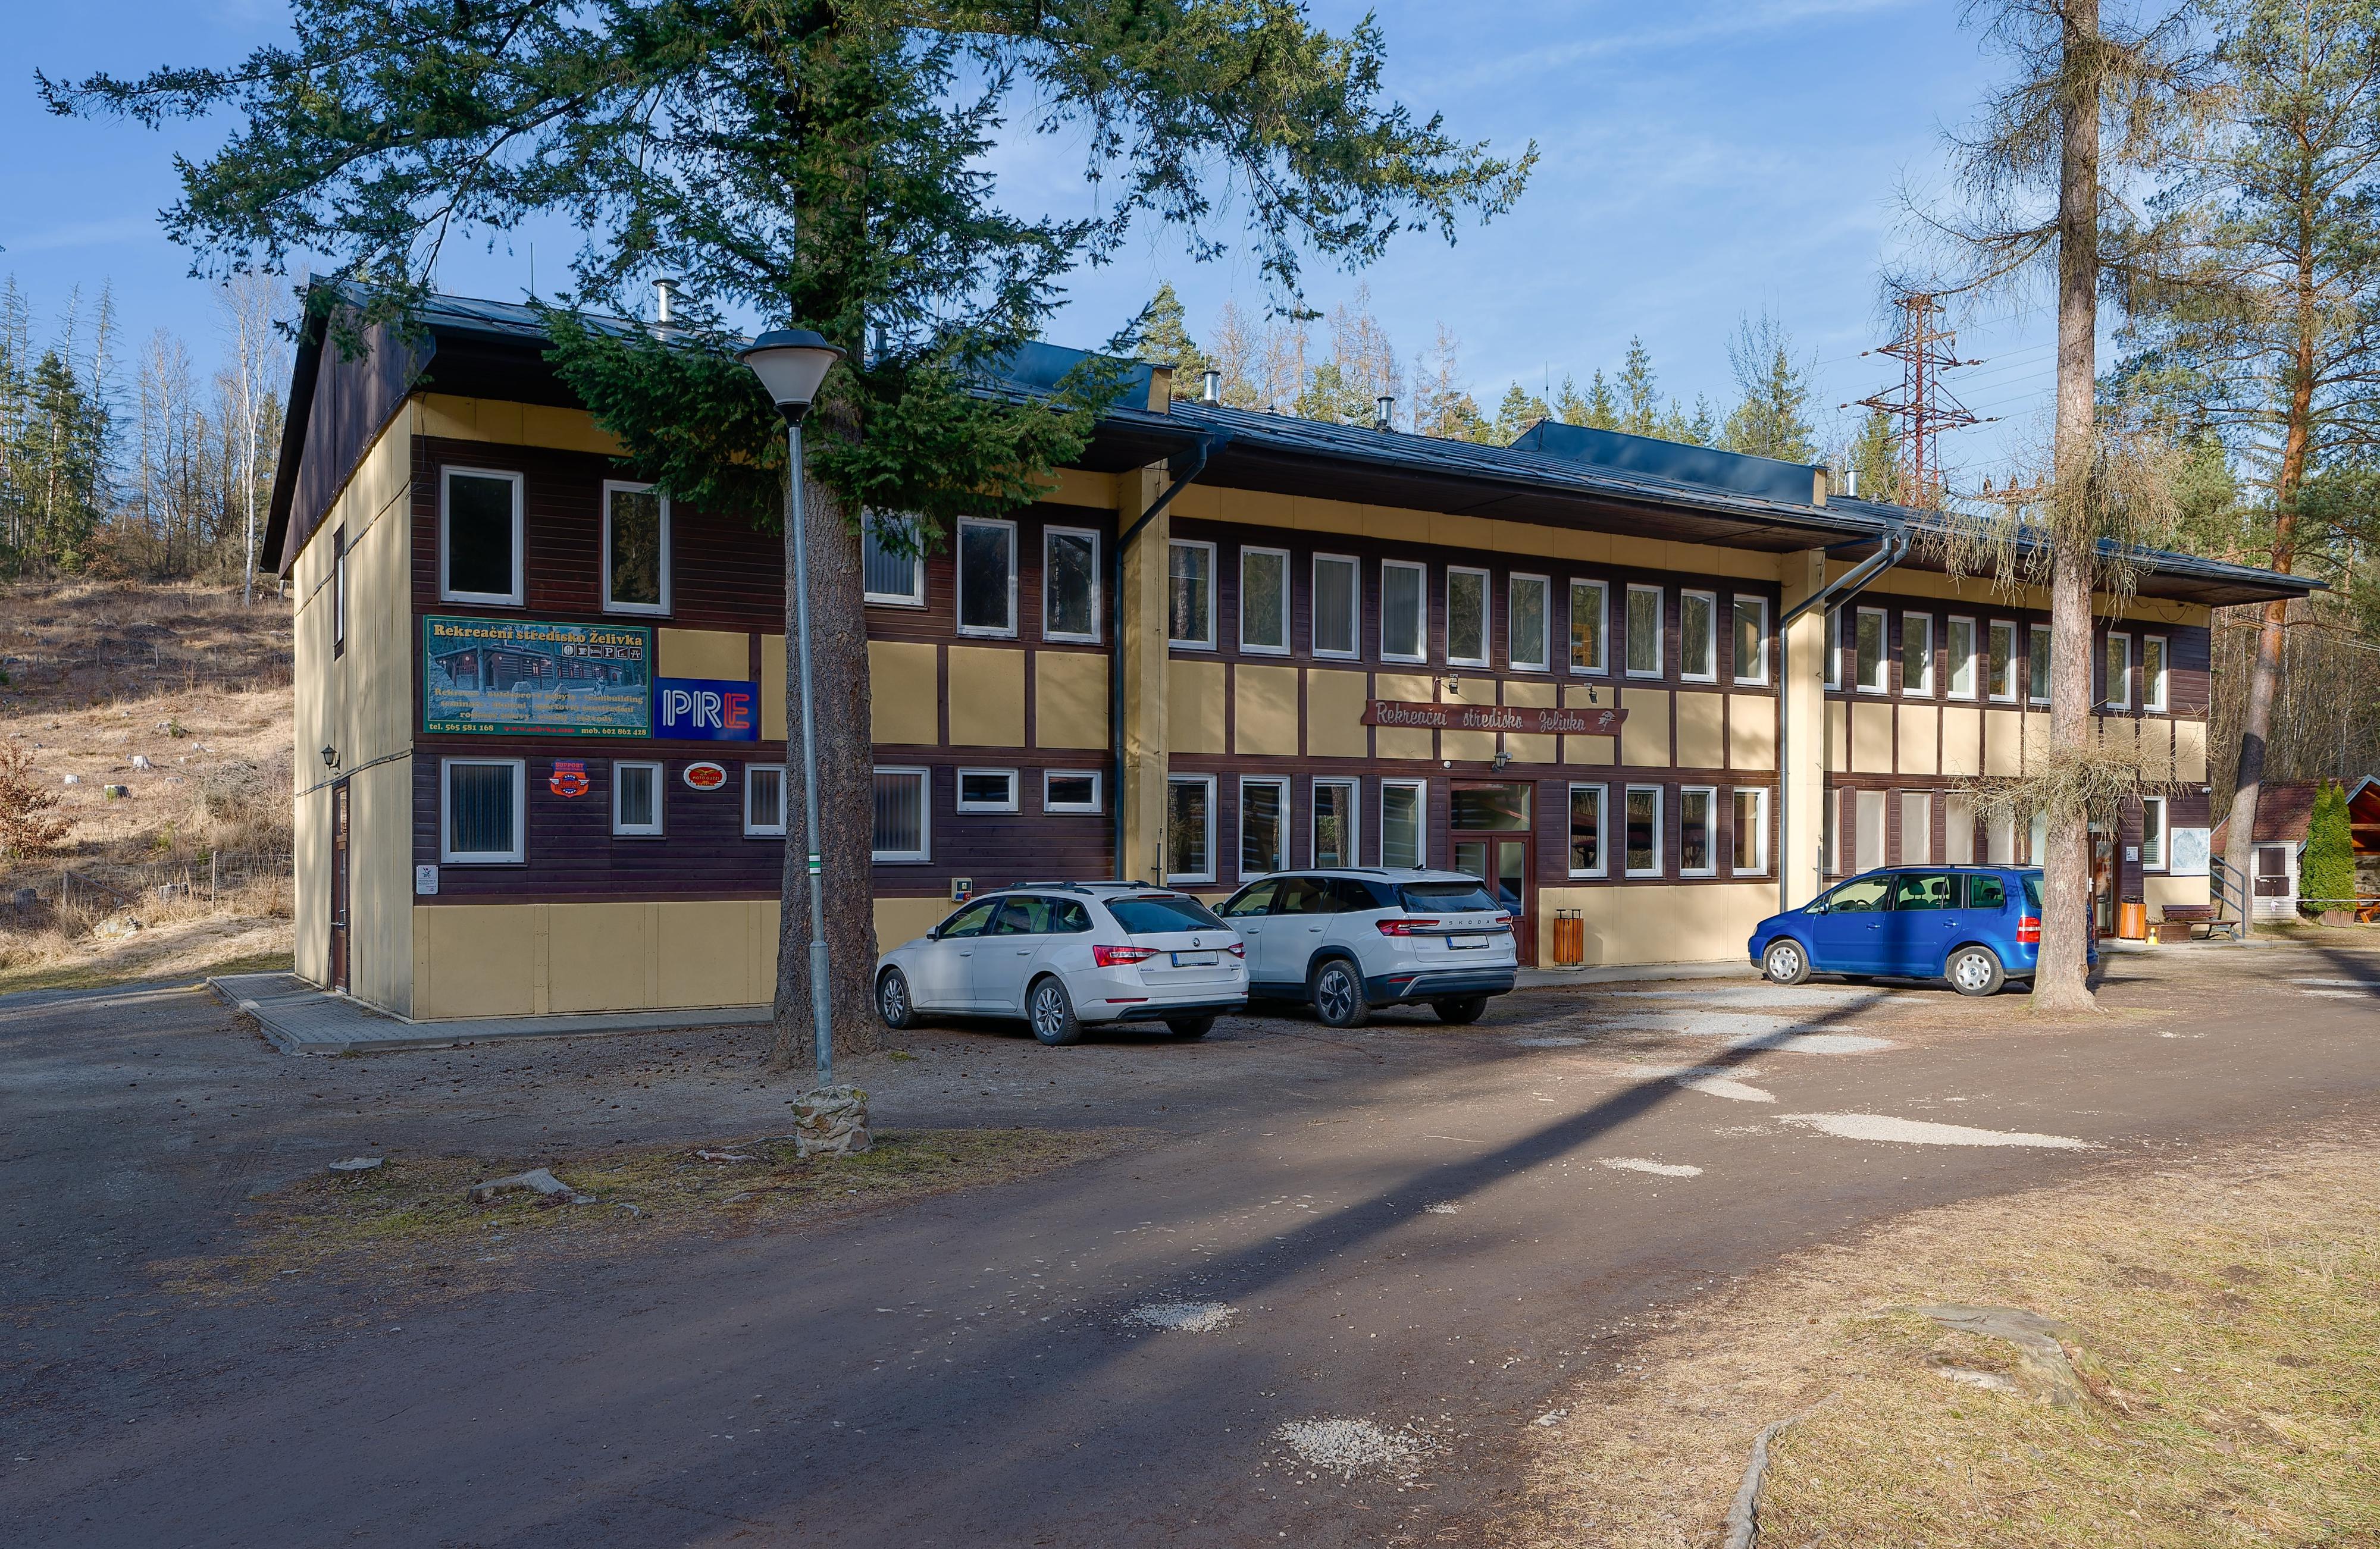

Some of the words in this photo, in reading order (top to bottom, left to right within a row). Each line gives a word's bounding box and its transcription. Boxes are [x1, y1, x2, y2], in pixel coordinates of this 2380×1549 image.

[434, 625, 513, 640] Rekreační
[516, 629, 586, 643] středisko
[589, 630, 643, 646] Želivka
[663, 689, 750, 729] PRE
[1375, 702, 1448, 726] Rekreační
[1463, 707, 1523, 729] středisko
[1539, 709, 1586, 733] Želivka
